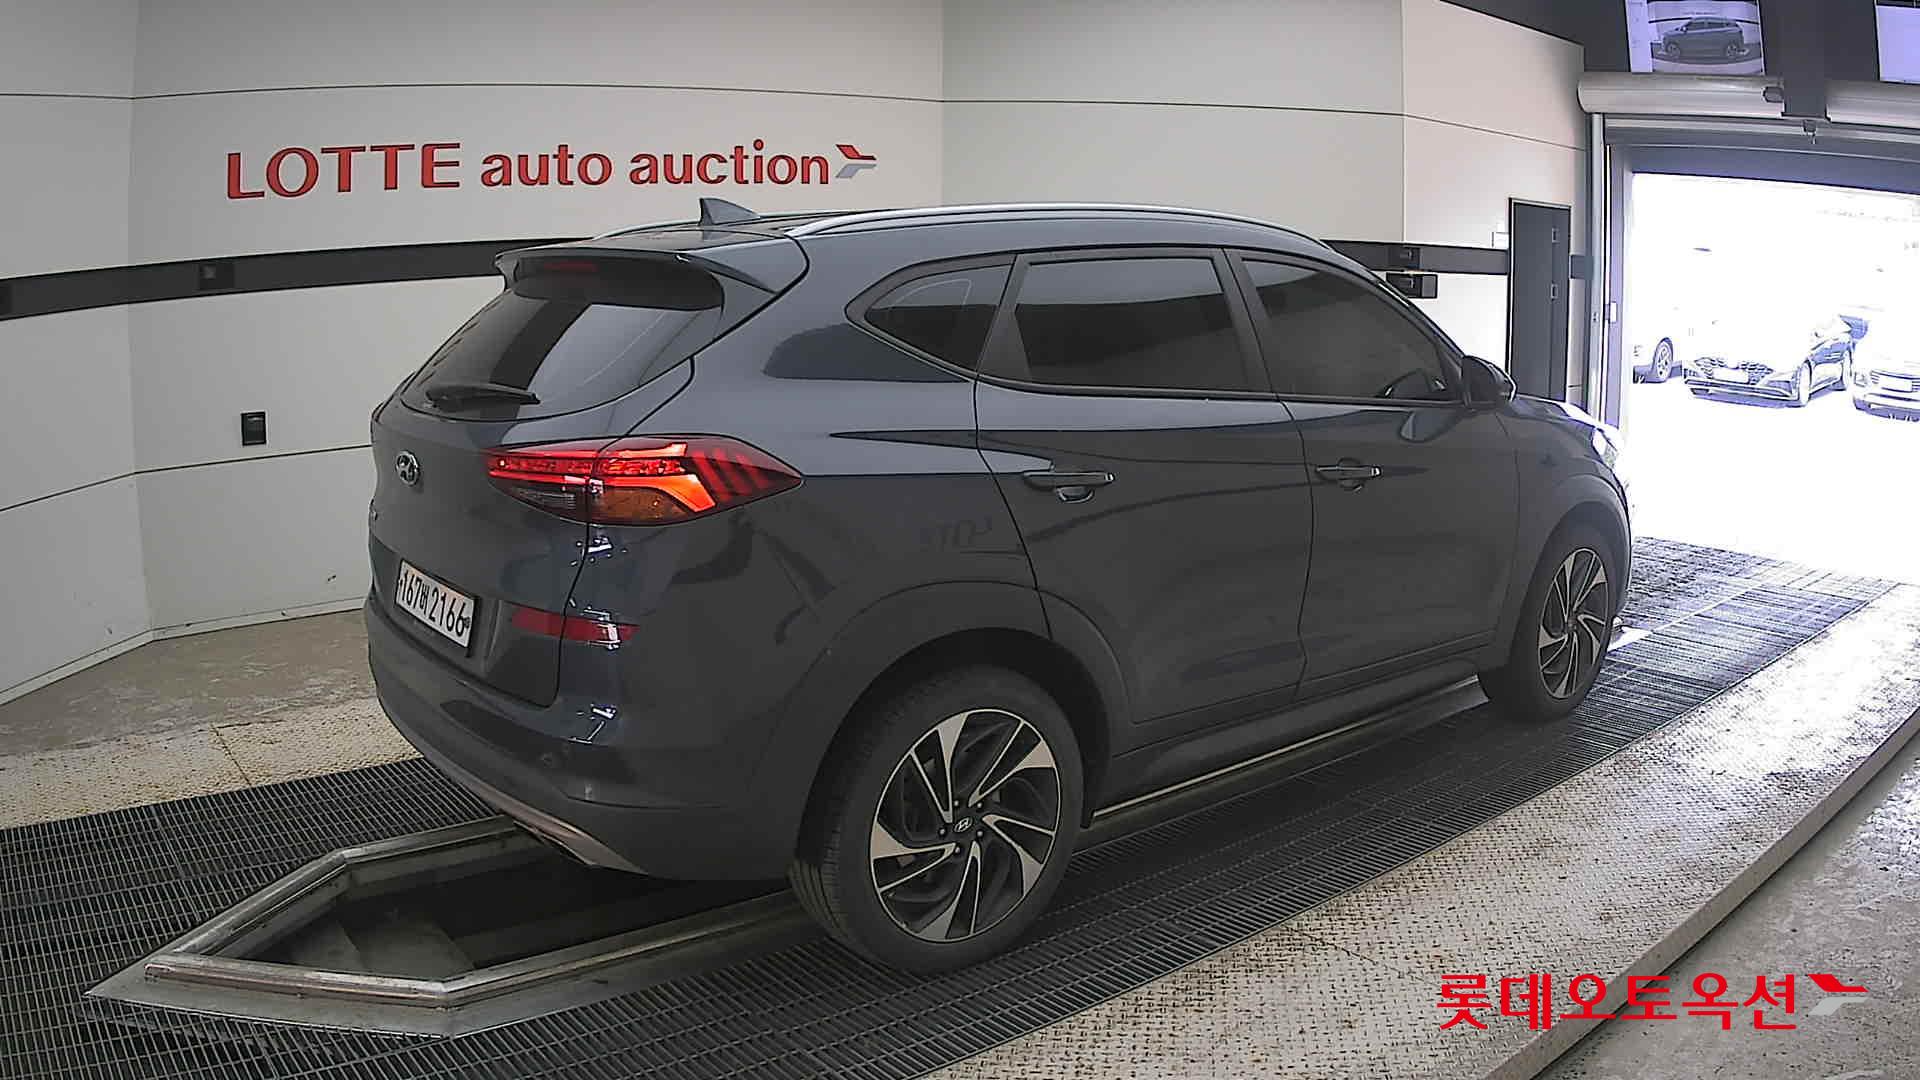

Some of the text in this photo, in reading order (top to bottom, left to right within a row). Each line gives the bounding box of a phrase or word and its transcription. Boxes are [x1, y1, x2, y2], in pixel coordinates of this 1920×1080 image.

[228, 140, 830, 199] LOTTE auto auction
[429, 587, 466, 637] 2166
